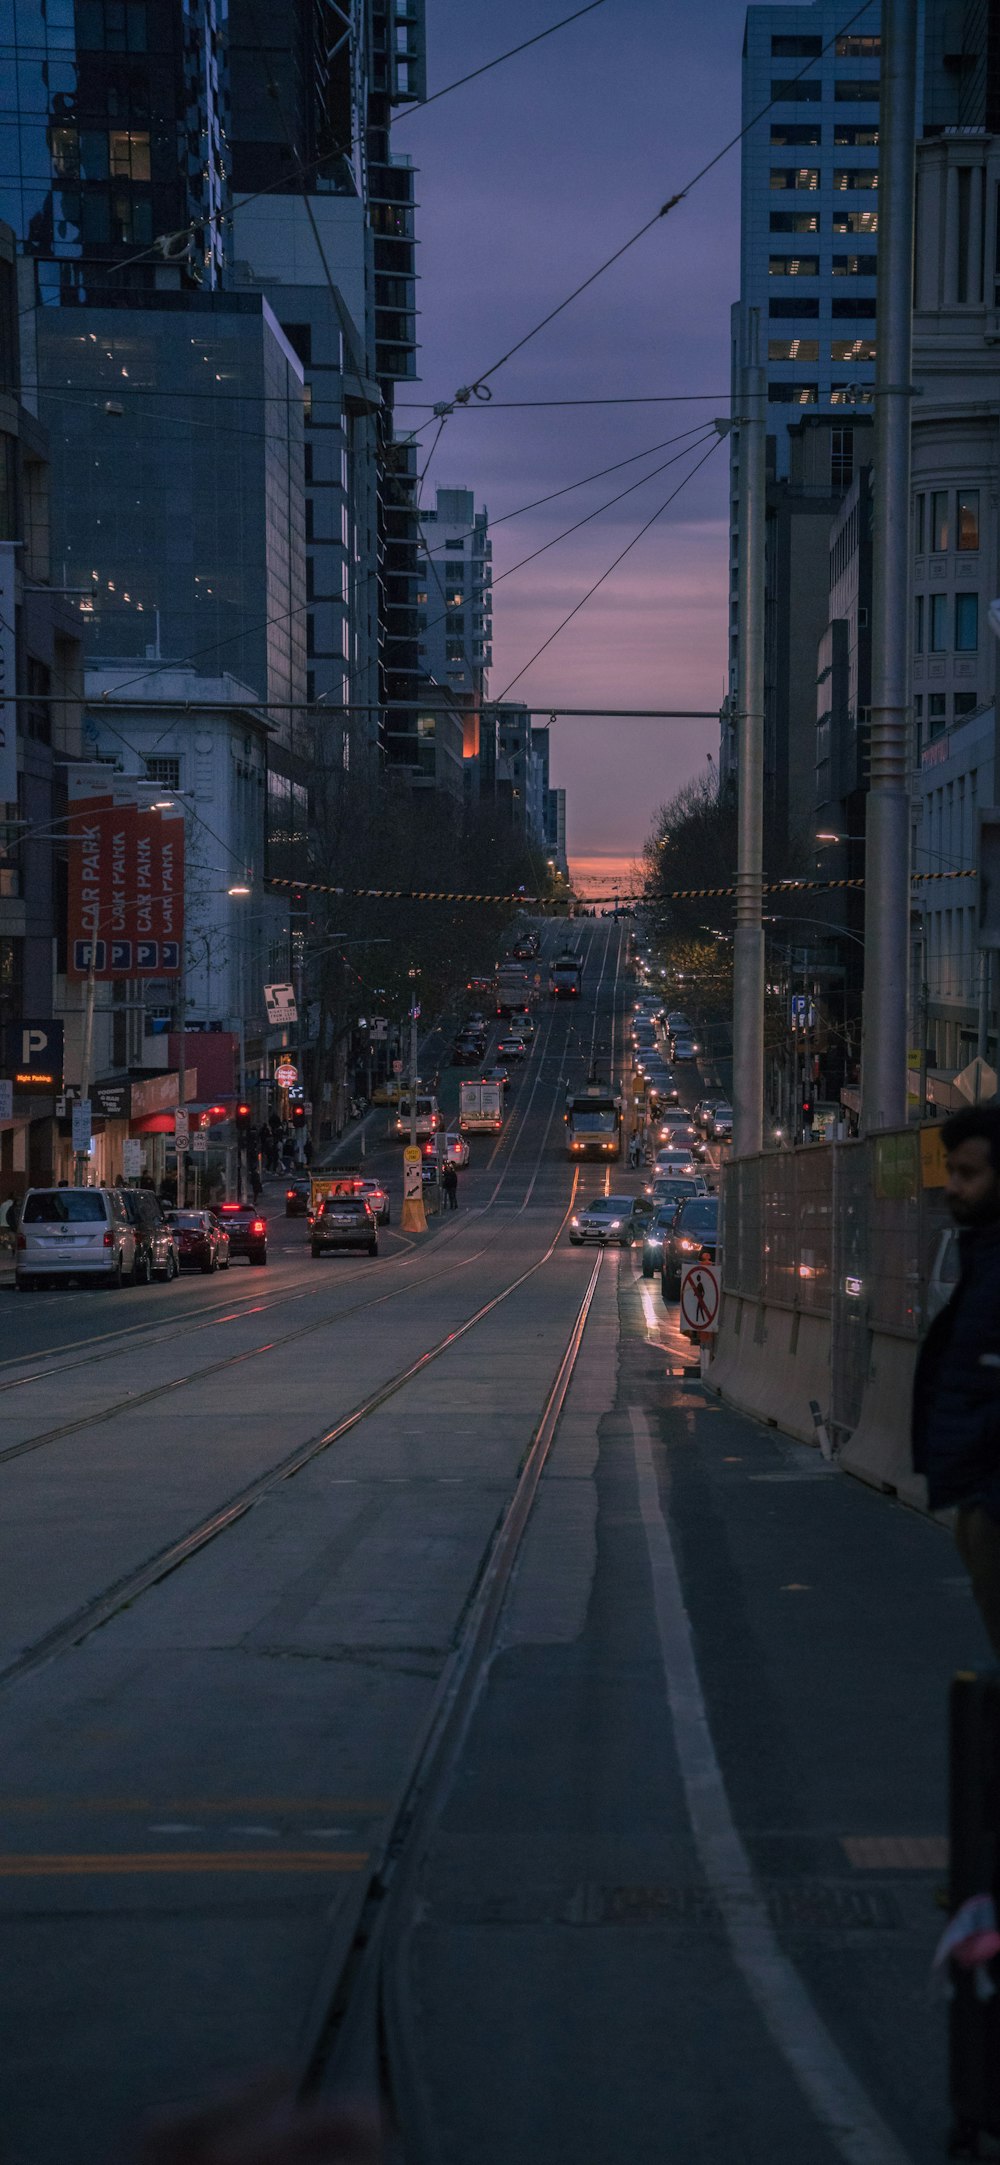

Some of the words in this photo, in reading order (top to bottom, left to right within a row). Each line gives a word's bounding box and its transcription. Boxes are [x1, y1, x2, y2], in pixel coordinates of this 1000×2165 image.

[81, 824, 101, 881] PARK
[136, 836, 151, 889] PARK
[81, 887, 101, 931] CAR
[136, 893, 151, 932] CAR
[112, 945, 124, 964] P
[137, 945, 151, 964] P
[797, 1000, 805, 1012] P
[22, 1029, 48, 1064] P
[31, 1074, 52, 1082] Parking
[178, 1138, 187, 1146] 30
